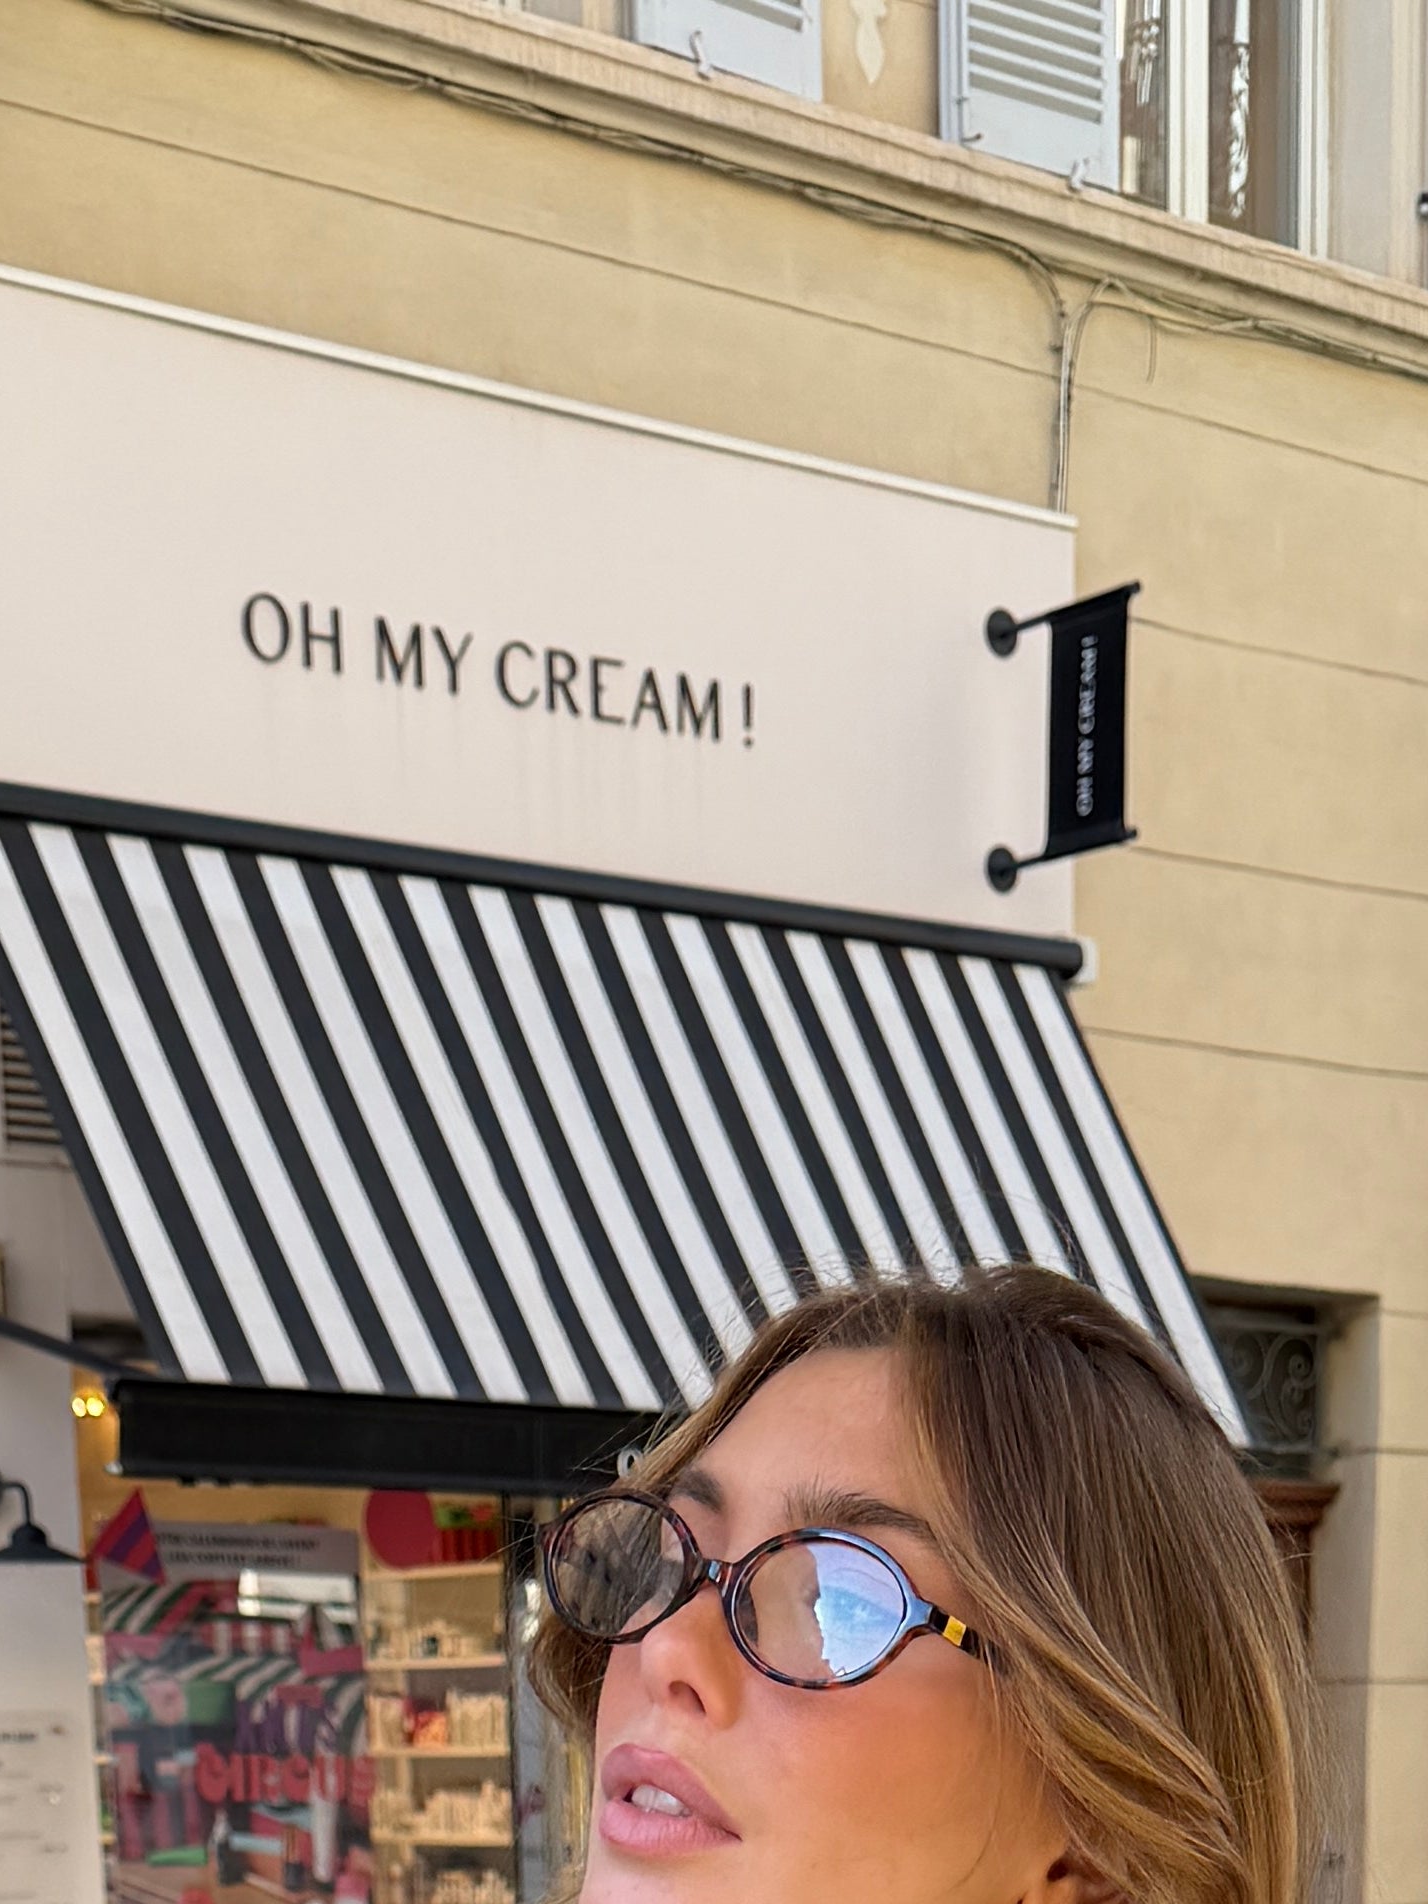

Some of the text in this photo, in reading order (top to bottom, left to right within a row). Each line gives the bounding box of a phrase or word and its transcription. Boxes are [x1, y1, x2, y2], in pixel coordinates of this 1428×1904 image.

[241, 591, 344, 676] OH
[373, 615, 474, 696] MY
[1077, 735, 1094, 775] MY
[1075, 776, 1093, 817] OH
